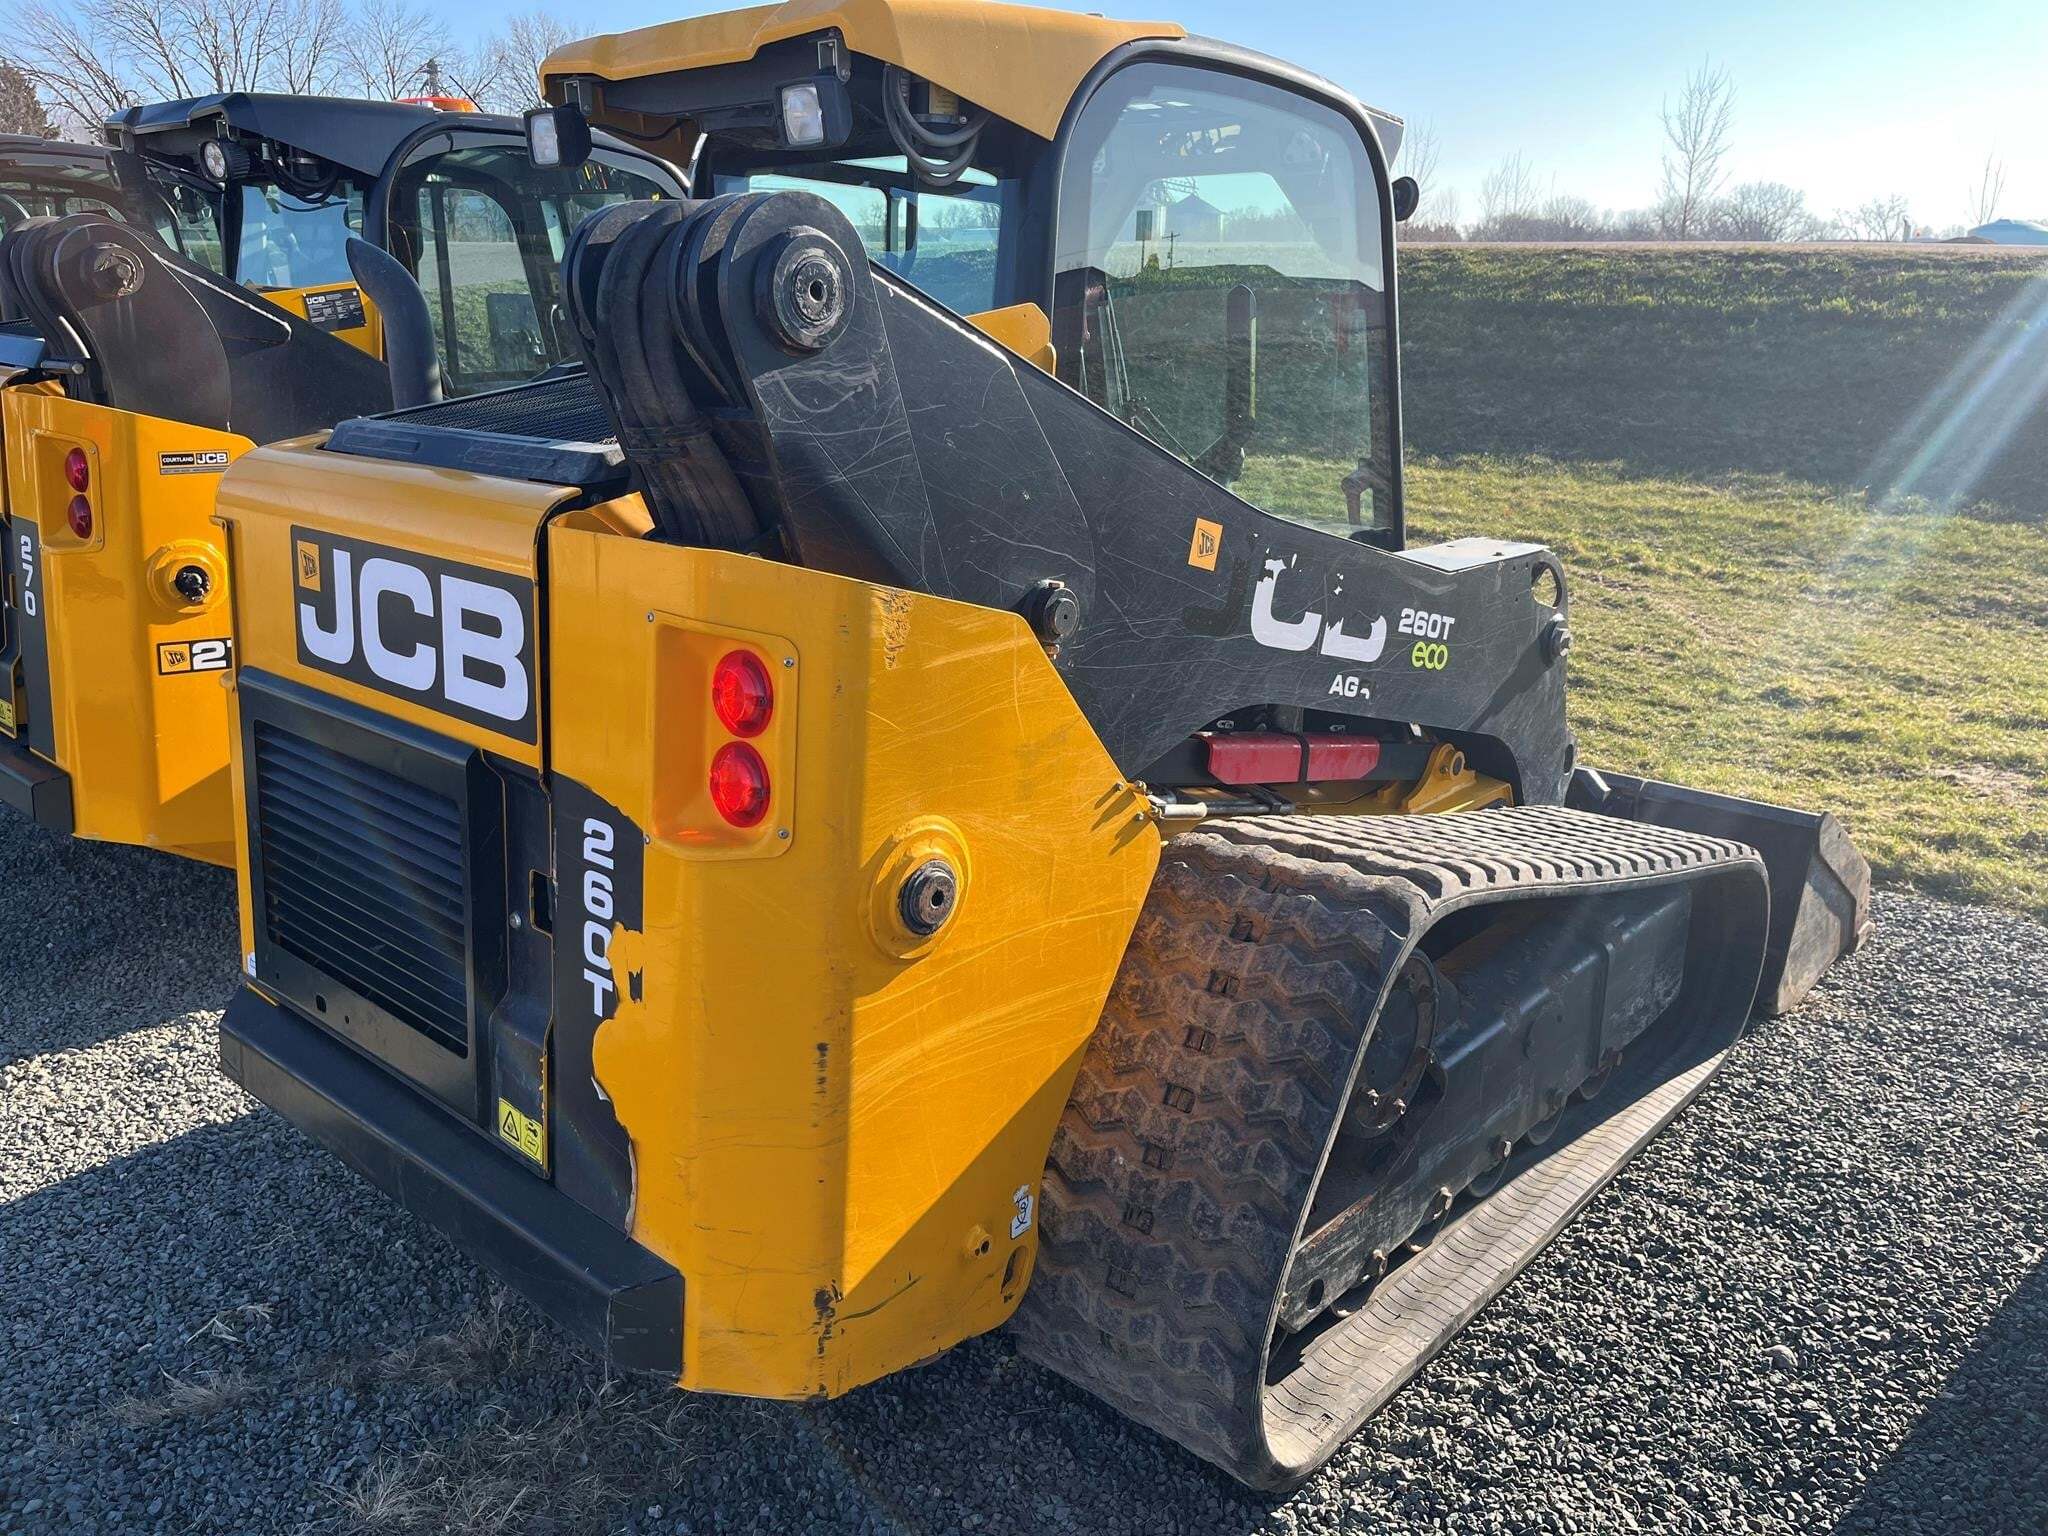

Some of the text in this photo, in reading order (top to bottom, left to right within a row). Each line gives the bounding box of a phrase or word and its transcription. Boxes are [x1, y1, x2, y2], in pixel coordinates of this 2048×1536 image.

[197, 453, 227, 464] JCB
[1199, 532, 1215, 554] JCB
[20, 534, 36, 616] 270
[300, 548, 529, 721] JCB
[1398, 608, 1455, 640] 260T
[192, 640, 232, 670] 2
[1411, 641, 1448, 670] eco
[583, 817, 614, 1017] 260T
